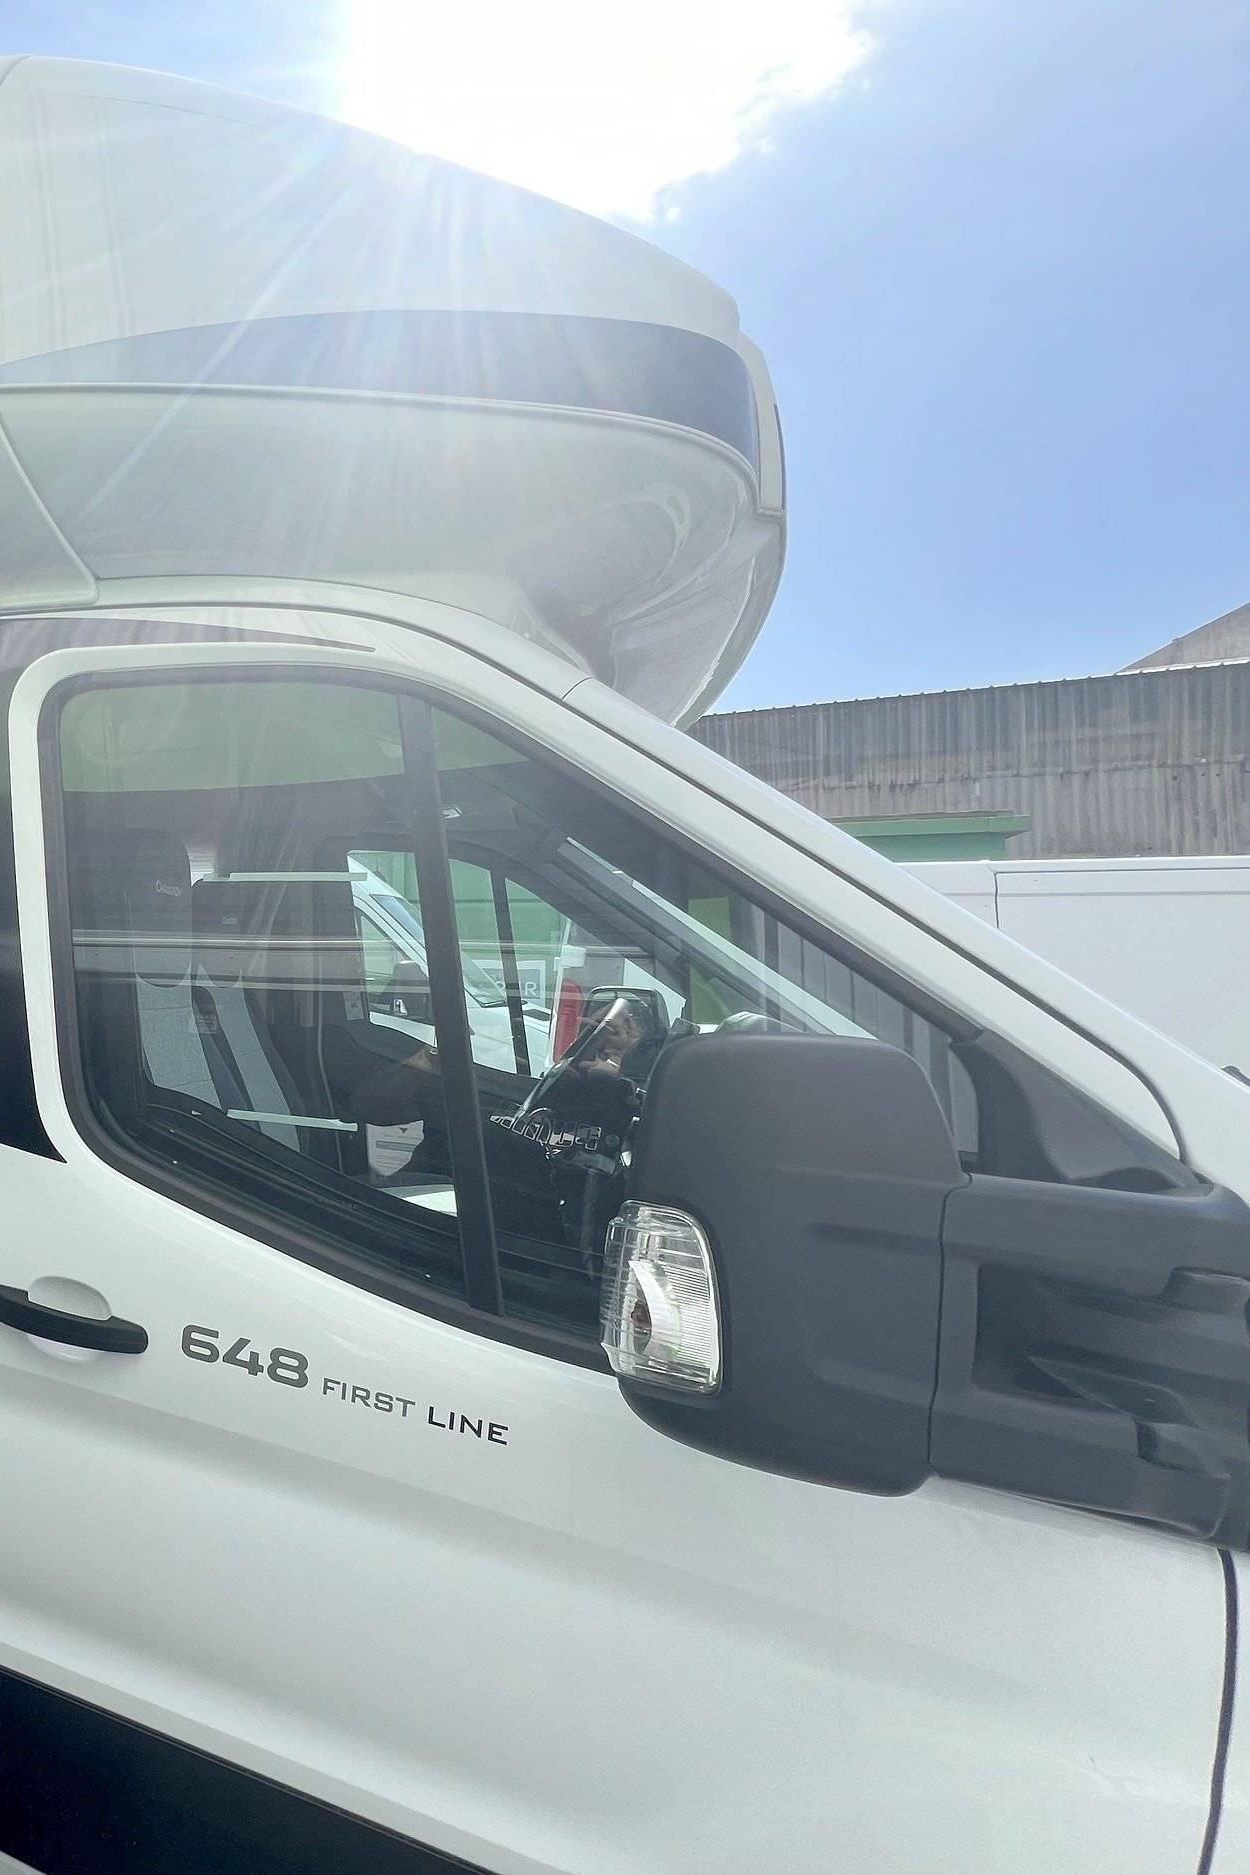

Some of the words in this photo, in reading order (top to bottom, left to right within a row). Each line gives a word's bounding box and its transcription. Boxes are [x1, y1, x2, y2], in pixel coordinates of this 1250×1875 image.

[181, 1324, 310, 1389] 648
[322, 1377, 416, 1418] FIRST
[428, 1406, 510, 1446] LINE
